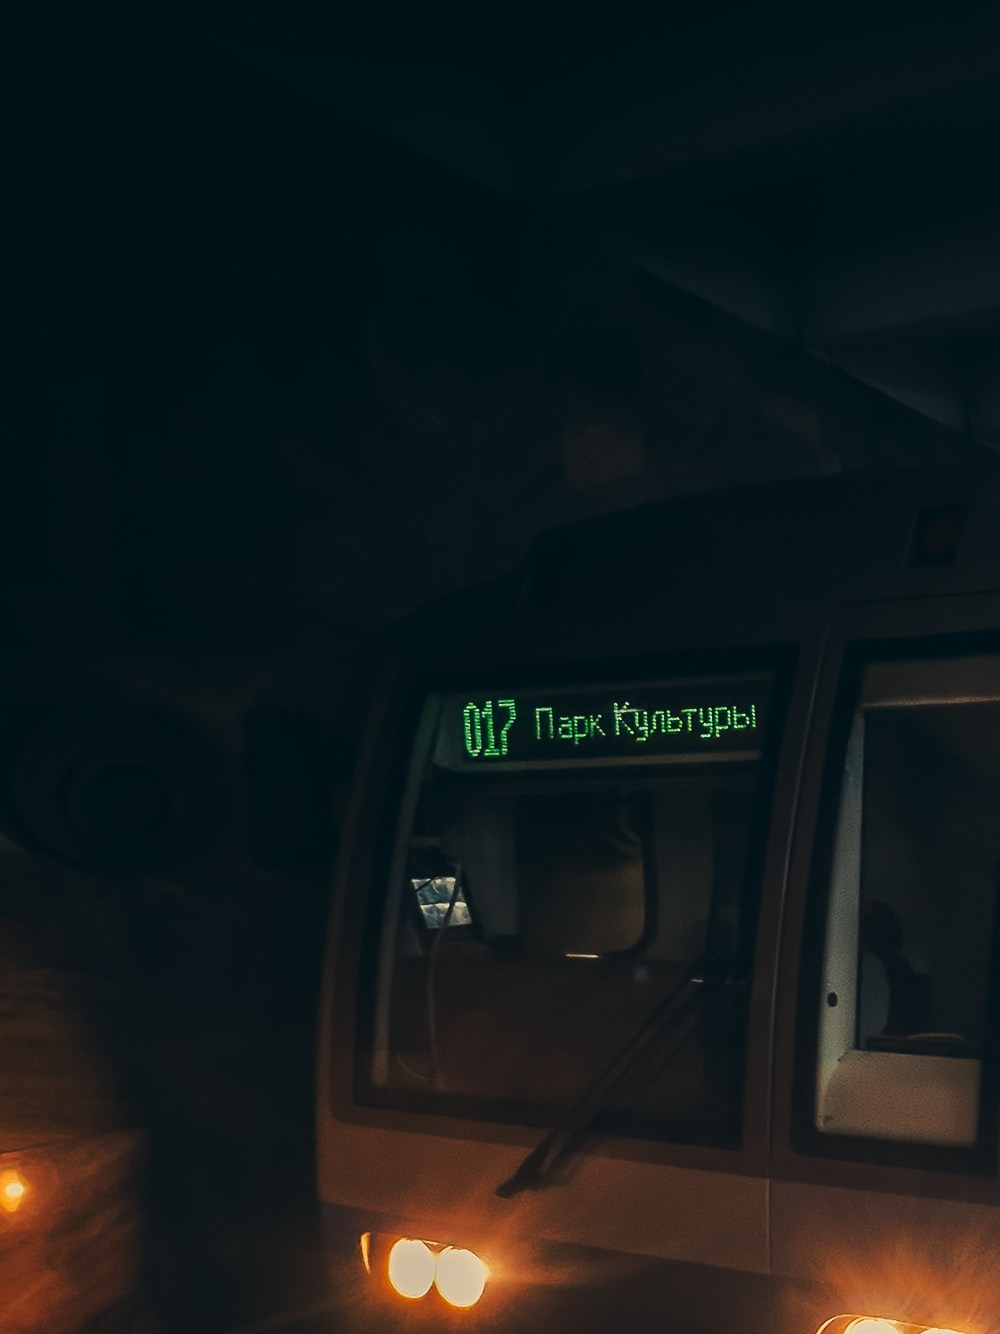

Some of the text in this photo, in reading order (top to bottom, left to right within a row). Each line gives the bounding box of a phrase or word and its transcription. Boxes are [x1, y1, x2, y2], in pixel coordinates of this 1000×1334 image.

[463, 699, 756, 757] 017 Парк Культуры
